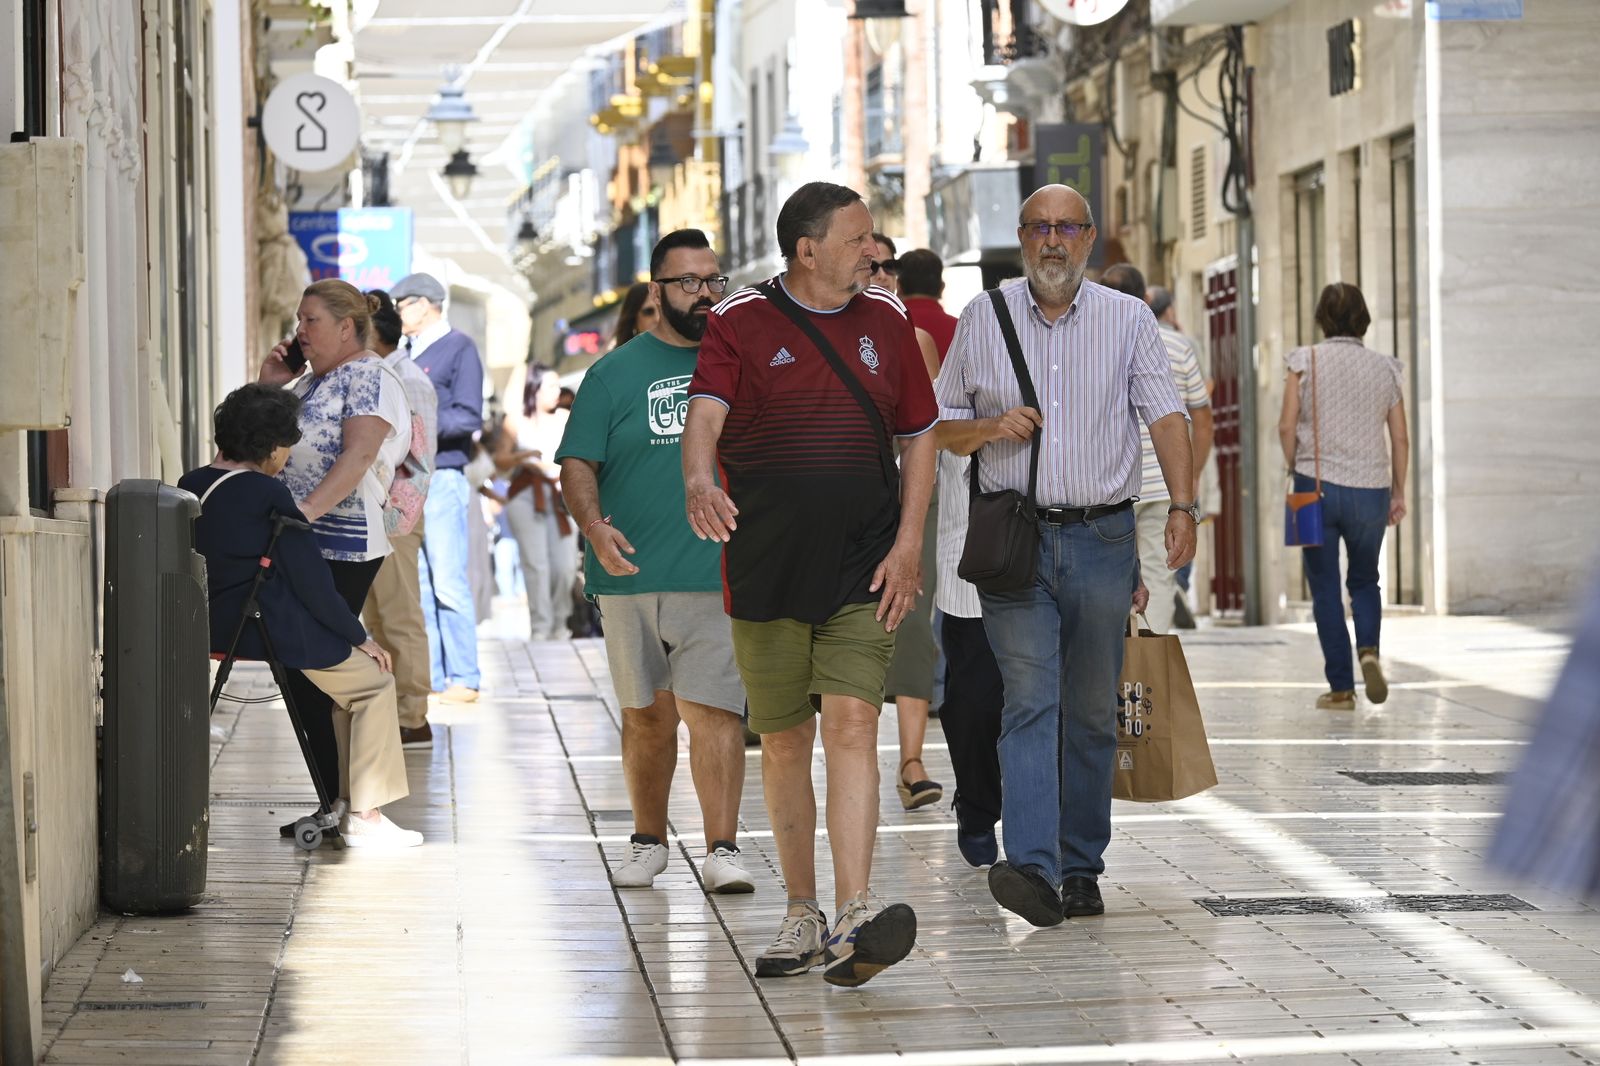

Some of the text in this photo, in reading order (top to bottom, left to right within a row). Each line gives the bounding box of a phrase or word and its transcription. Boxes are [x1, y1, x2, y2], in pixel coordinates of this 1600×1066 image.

[769, 356, 796, 367] adidas
[1124, 681, 1143, 698] PO
[1125, 700, 1142, 717] DE
[1125, 718, 1143, 736] DO
